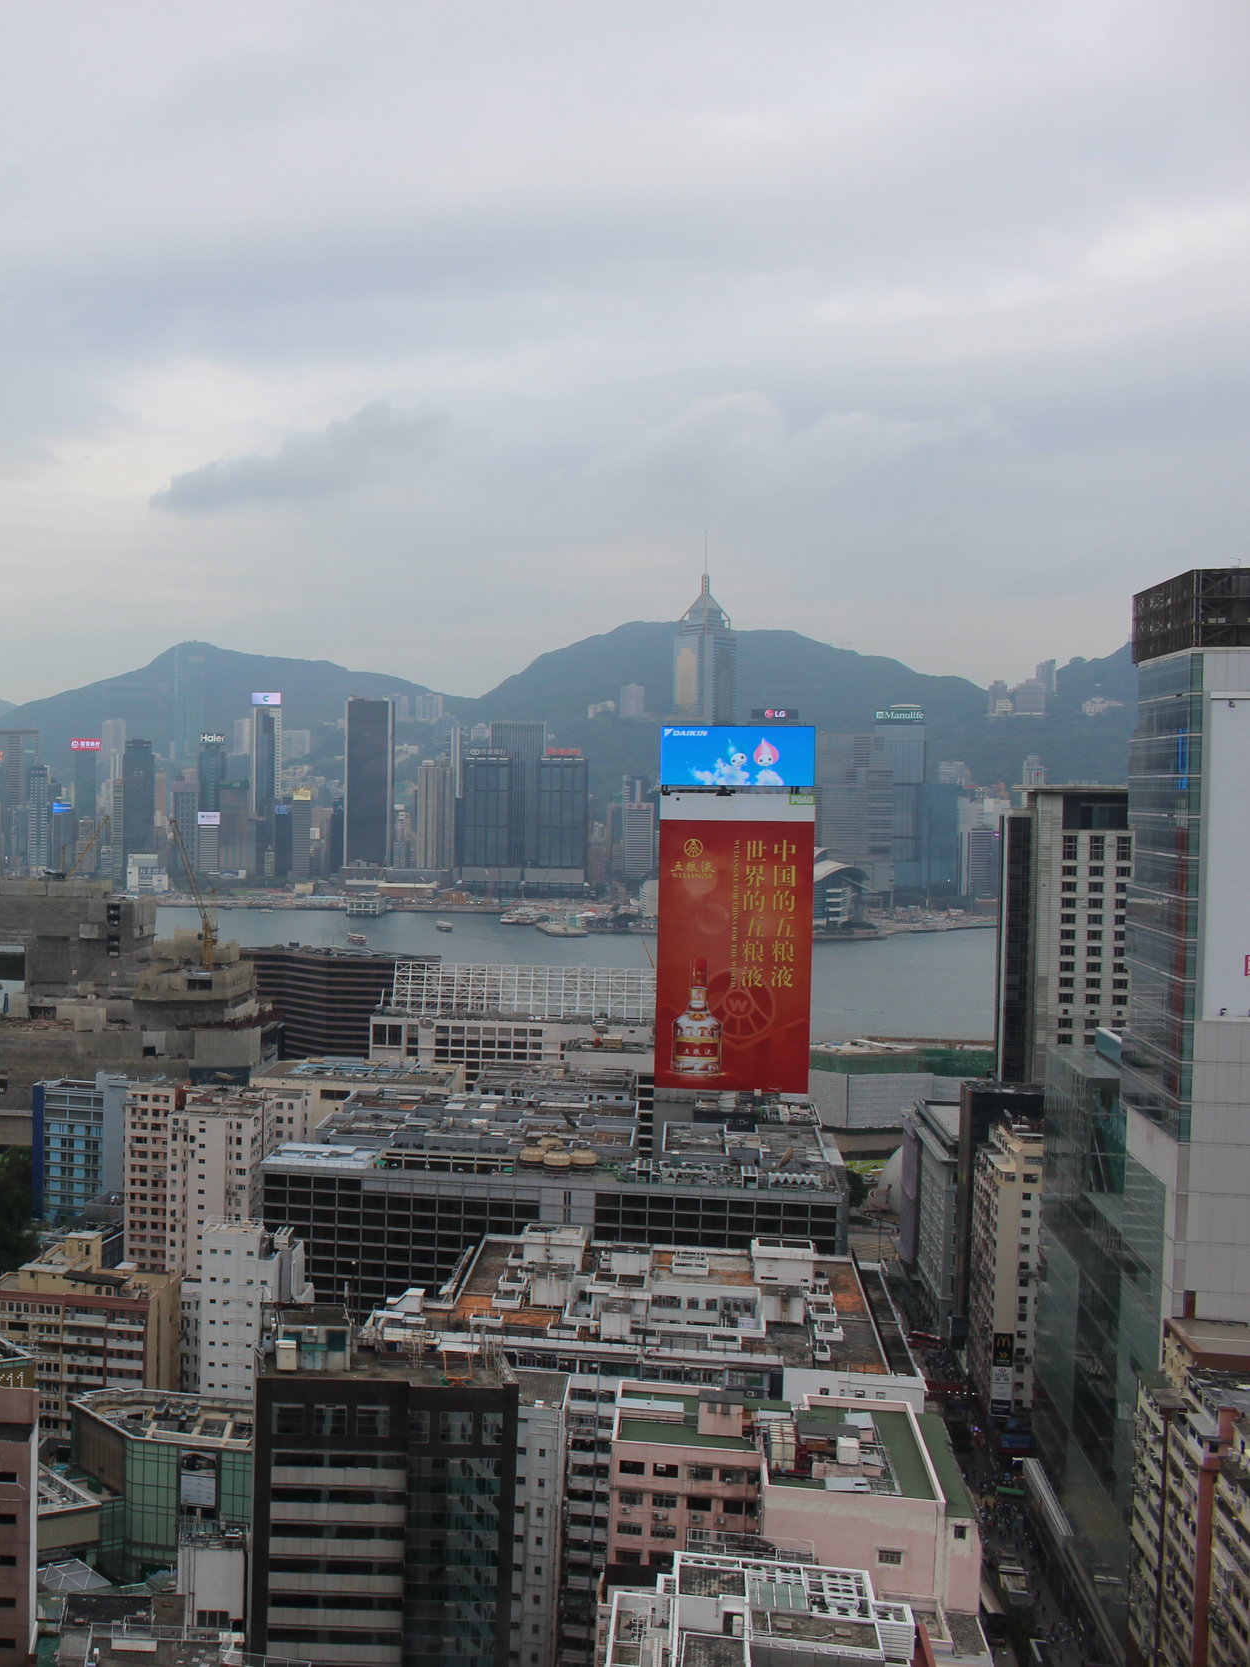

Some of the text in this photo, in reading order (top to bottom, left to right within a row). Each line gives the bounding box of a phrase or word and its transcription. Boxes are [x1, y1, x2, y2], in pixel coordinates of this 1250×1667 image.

[774, 710, 786, 718] LG
[884, 711, 924, 719] Manulife
[200, 734, 225, 743] Haier
[791, 796, 814, 805] POAD
[742, 840, 766, 988] 世界的五粮液
[771, 840, 796, 988] 中国的五粮液
